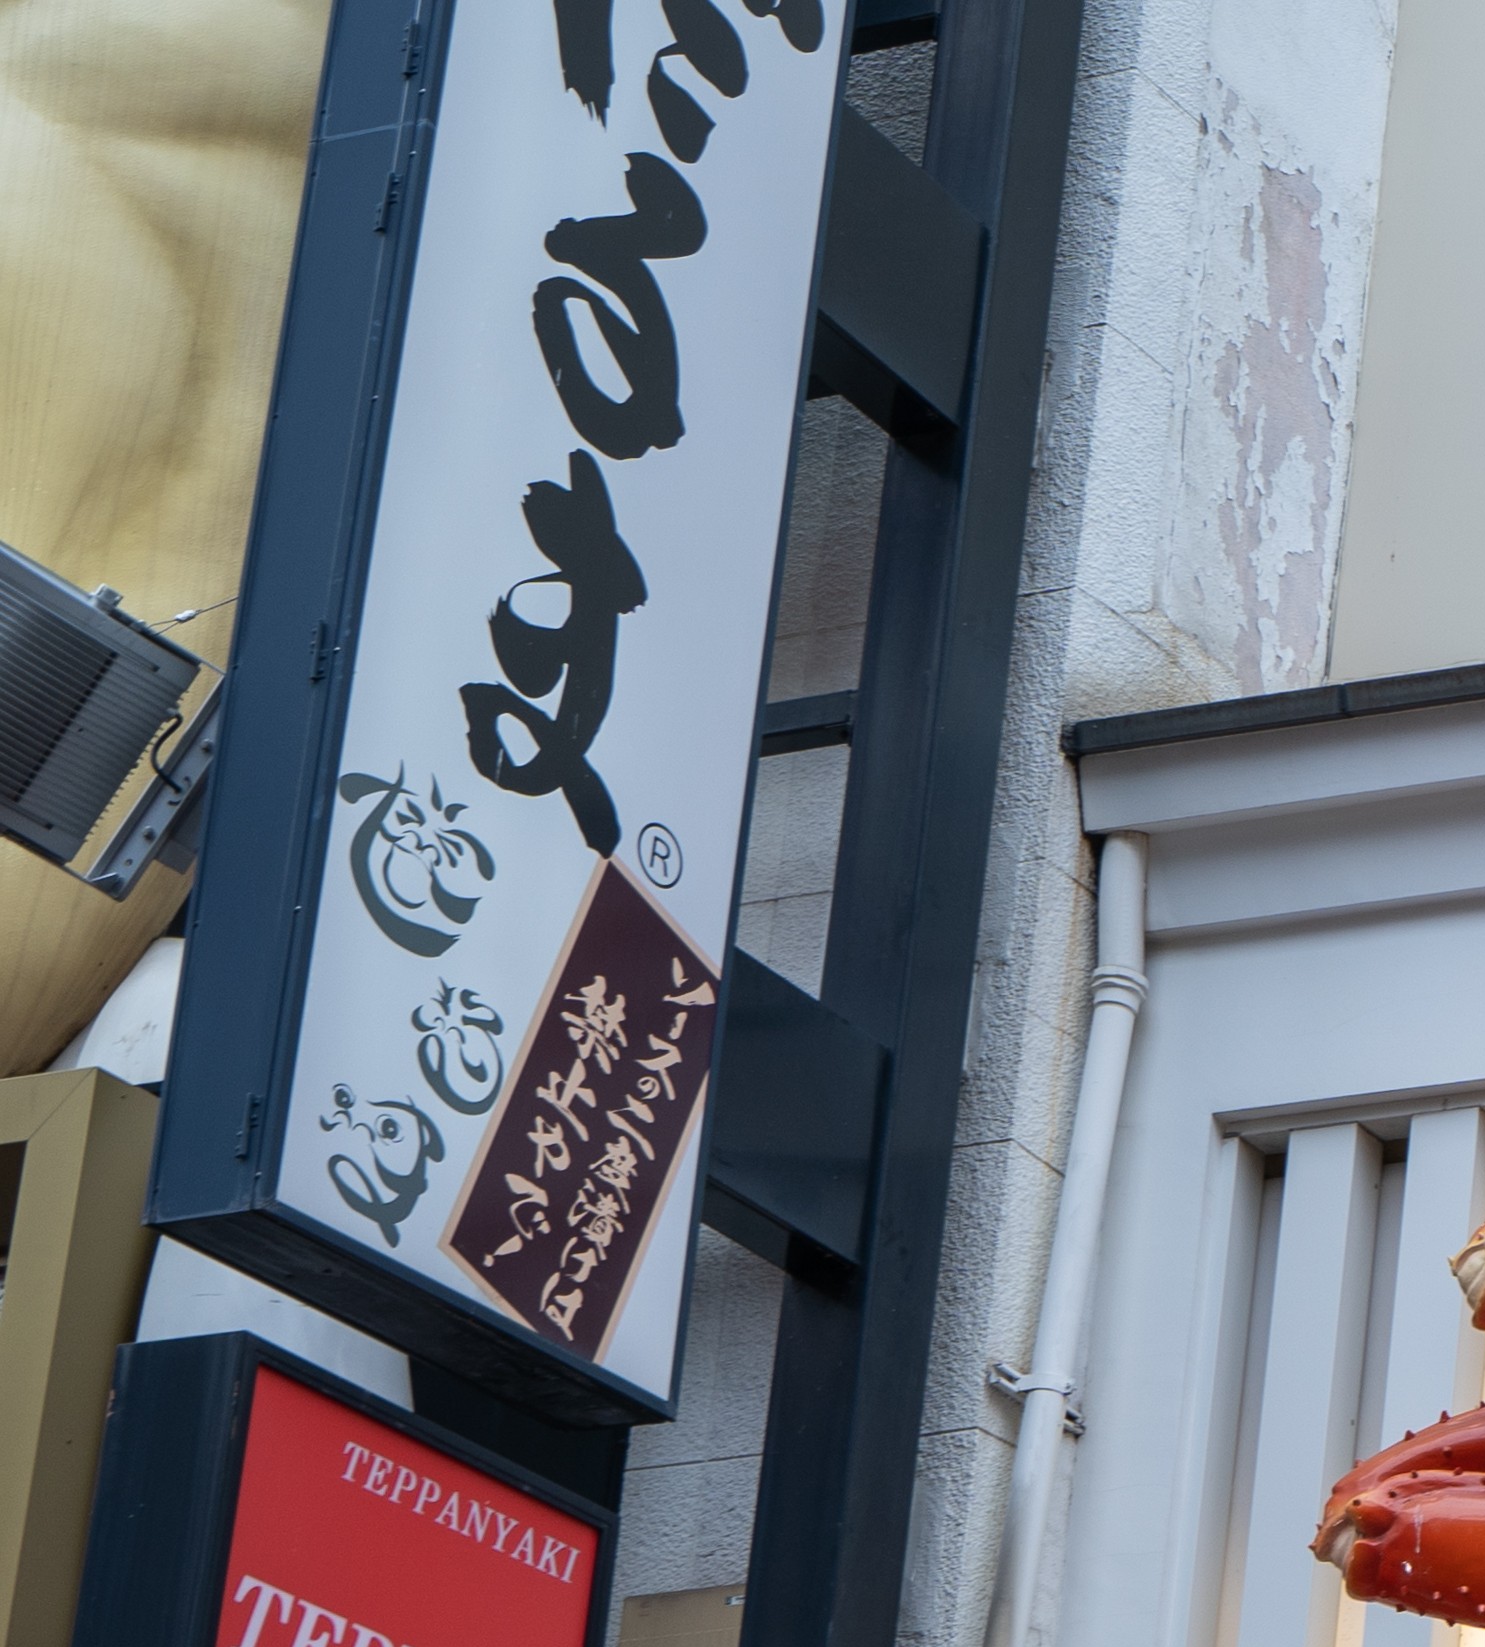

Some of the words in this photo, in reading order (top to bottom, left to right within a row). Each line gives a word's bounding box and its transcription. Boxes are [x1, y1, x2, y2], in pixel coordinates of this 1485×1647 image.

[539, 955, 716, 1343] ソースの二度漬けは
[341, 1441, 583, 1584] TEPPANYAKI
